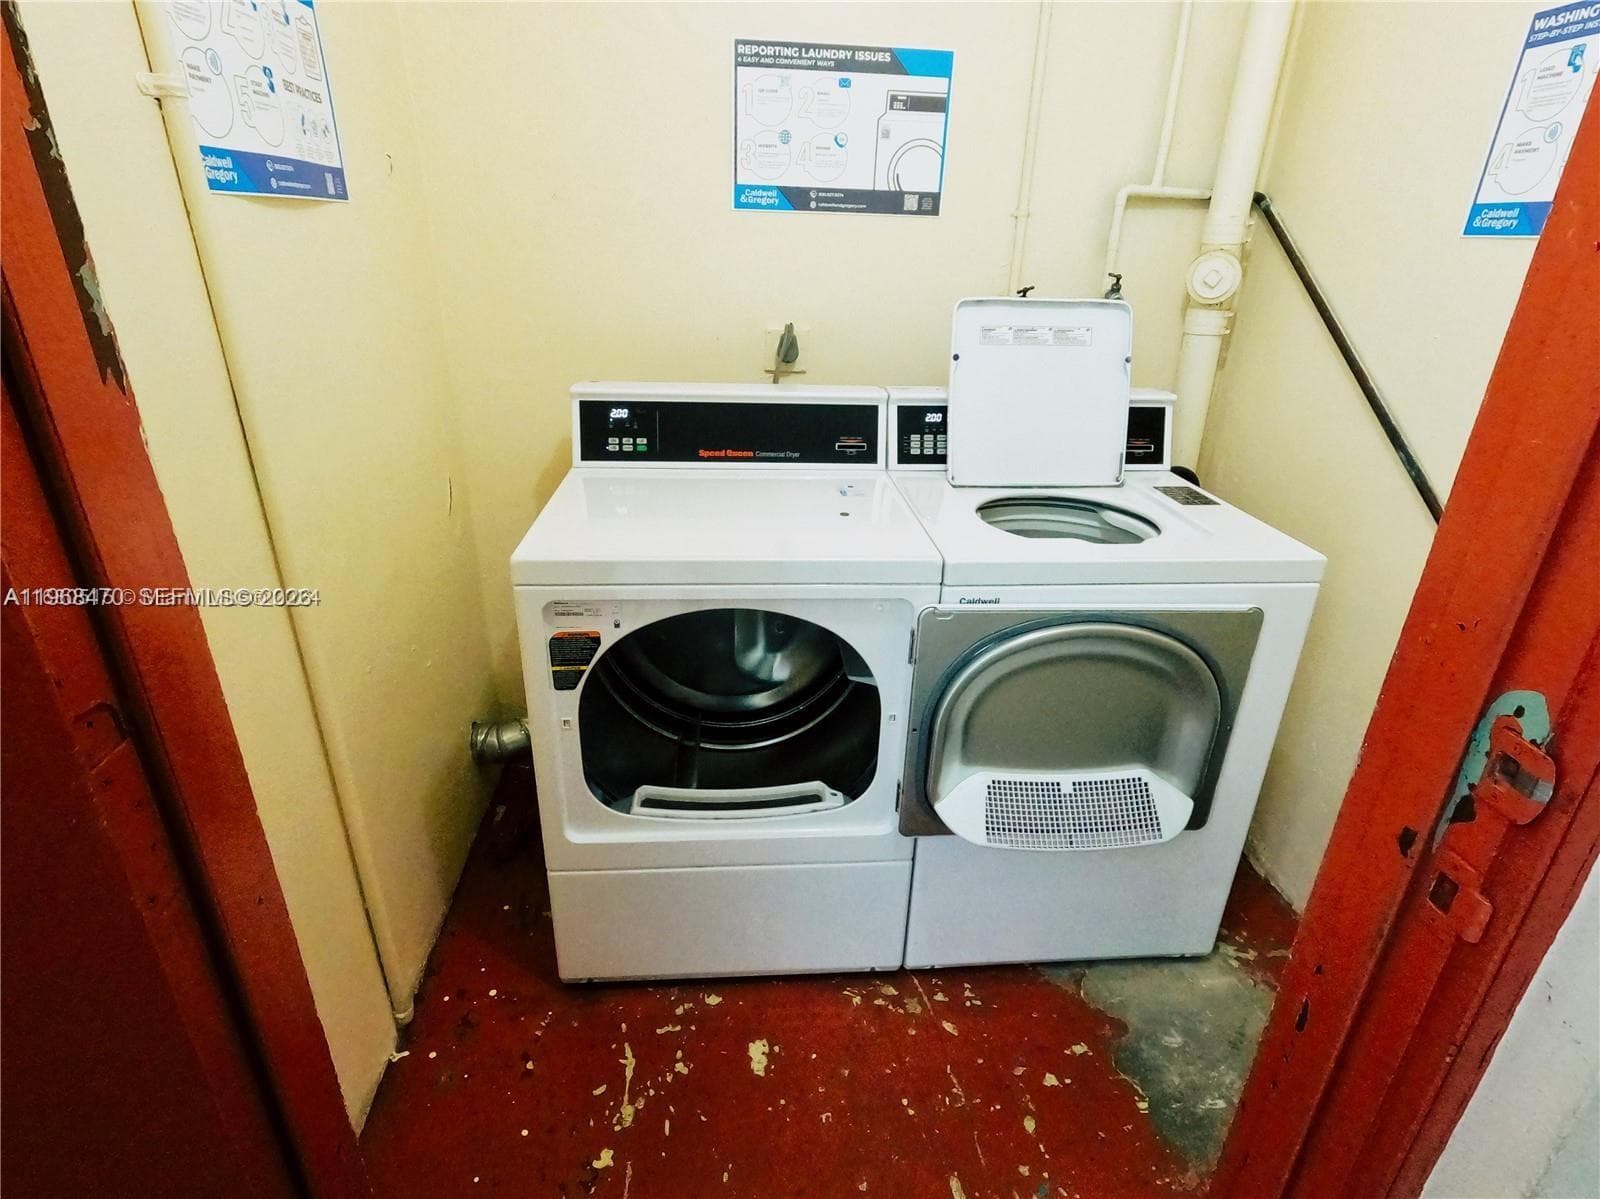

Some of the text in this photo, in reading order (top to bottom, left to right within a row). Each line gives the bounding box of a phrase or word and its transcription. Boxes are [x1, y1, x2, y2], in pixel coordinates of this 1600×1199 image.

[1534, 4, 1600, 31] WASHING
[1528, 23, 1584, 43] STEP-BY-STEP
[737, 45, 891, 63] REPORTING LAUNDRY ISSUES
[776, 58, 816, 66] CONVENIENT
[744, 189, 776, 197] Caldwell
[1481, 208, 1520, 218] Caldwell
[1472, 216, 1518, 230] &Gregory
[699, 449, 725, 458] Speed
[785, 450, 800, 458] Dryer
[960, 596, 1001, 605] Caldwell
